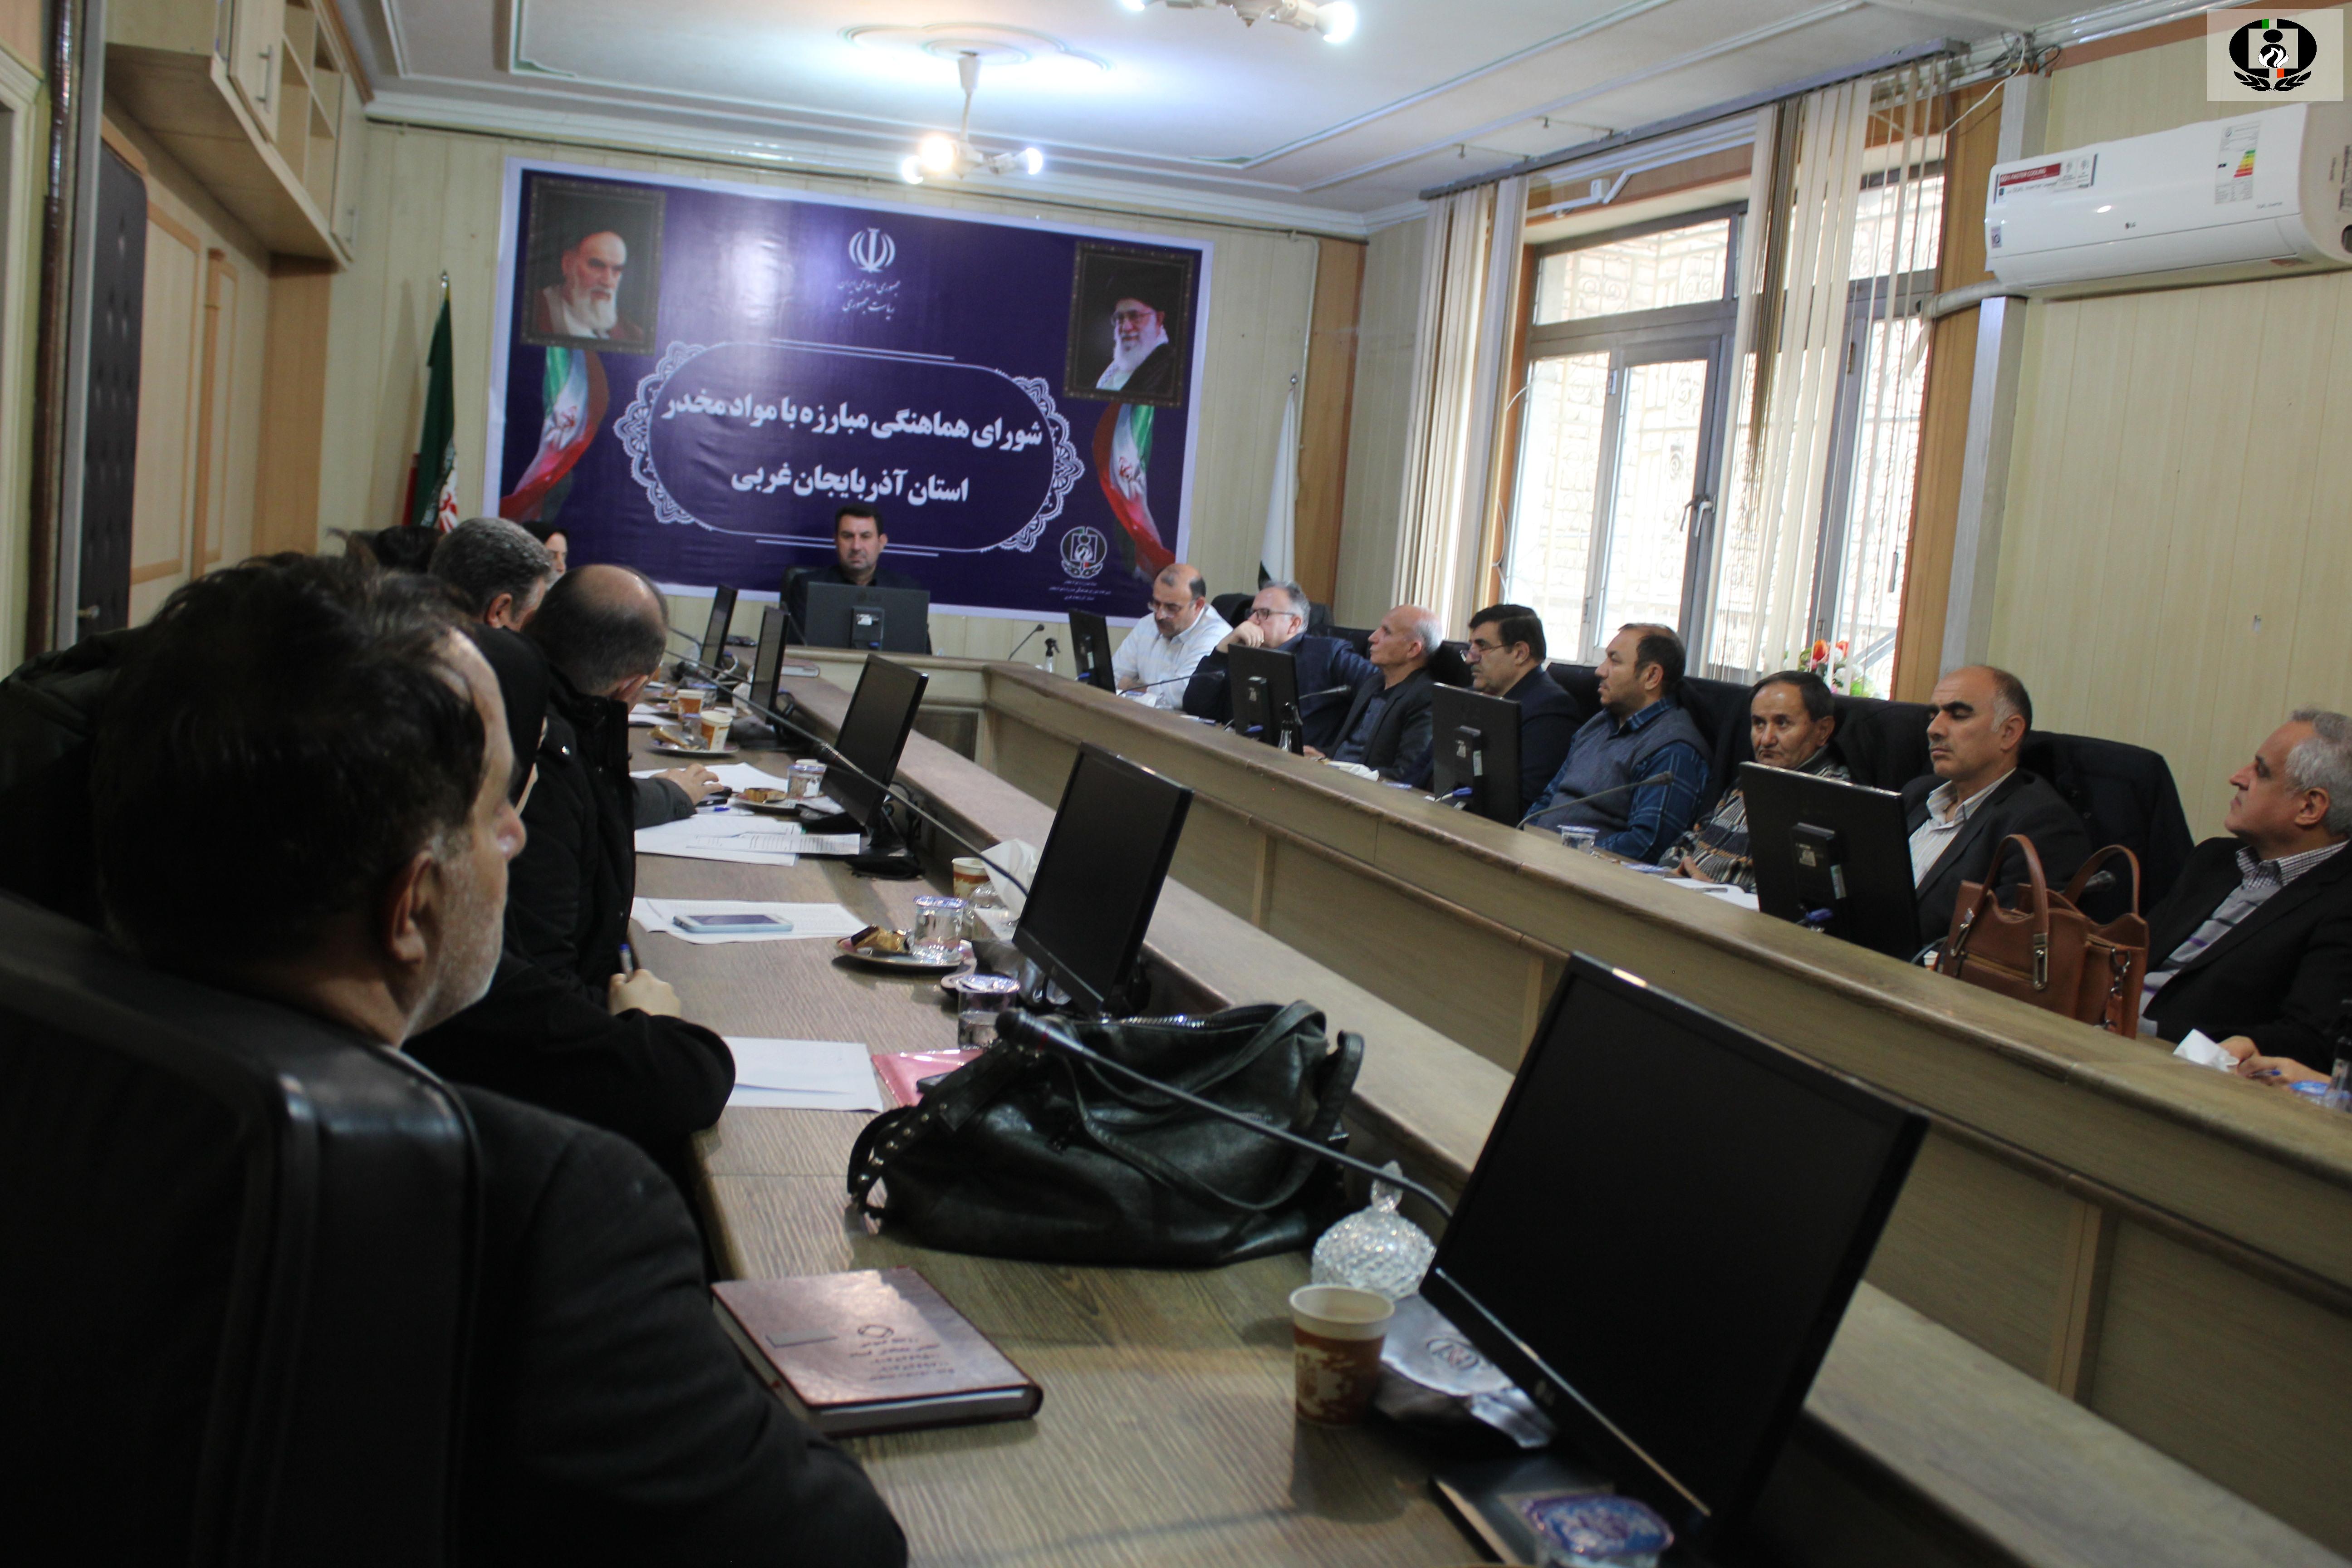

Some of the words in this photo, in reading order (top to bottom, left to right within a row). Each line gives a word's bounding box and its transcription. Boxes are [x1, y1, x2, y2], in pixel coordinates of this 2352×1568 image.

[661, 388, 726, 420] مخدر
[729, 393, 778, 427] مواد
[780, 396, 798, 429] با
[799, 402, 869, 434] مبارزه
[871, 408, 970, 439] هماهنگی
[971, 416, 1043, 451] شورای
[731, 462, 792, 494] غربی
[793, 464, 908, 502] آذربایجان
[907, 474, 969, 506] استان
